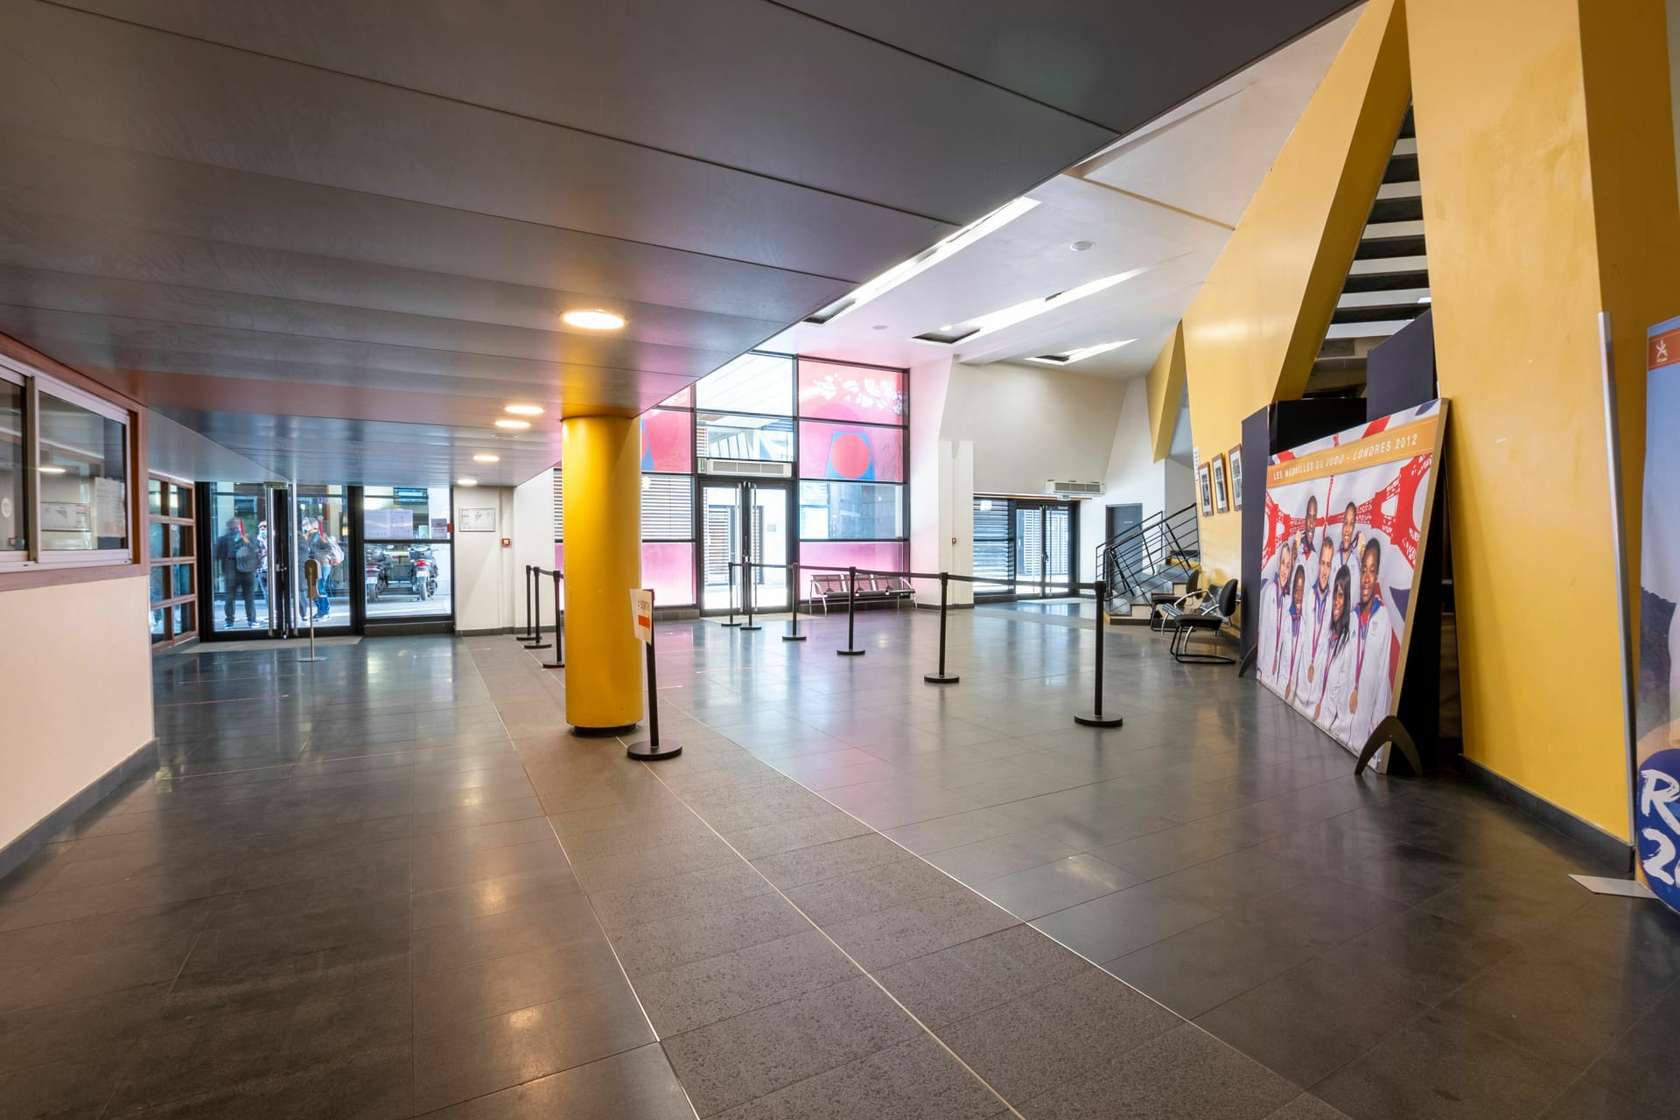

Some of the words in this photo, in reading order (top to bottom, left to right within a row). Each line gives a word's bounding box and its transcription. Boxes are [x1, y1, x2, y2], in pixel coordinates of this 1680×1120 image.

[1352, 440, 1392, 461] LONDRES
[1395, 433, 1419, 449] 2012
[1641, 828, 1680, 888] 2
